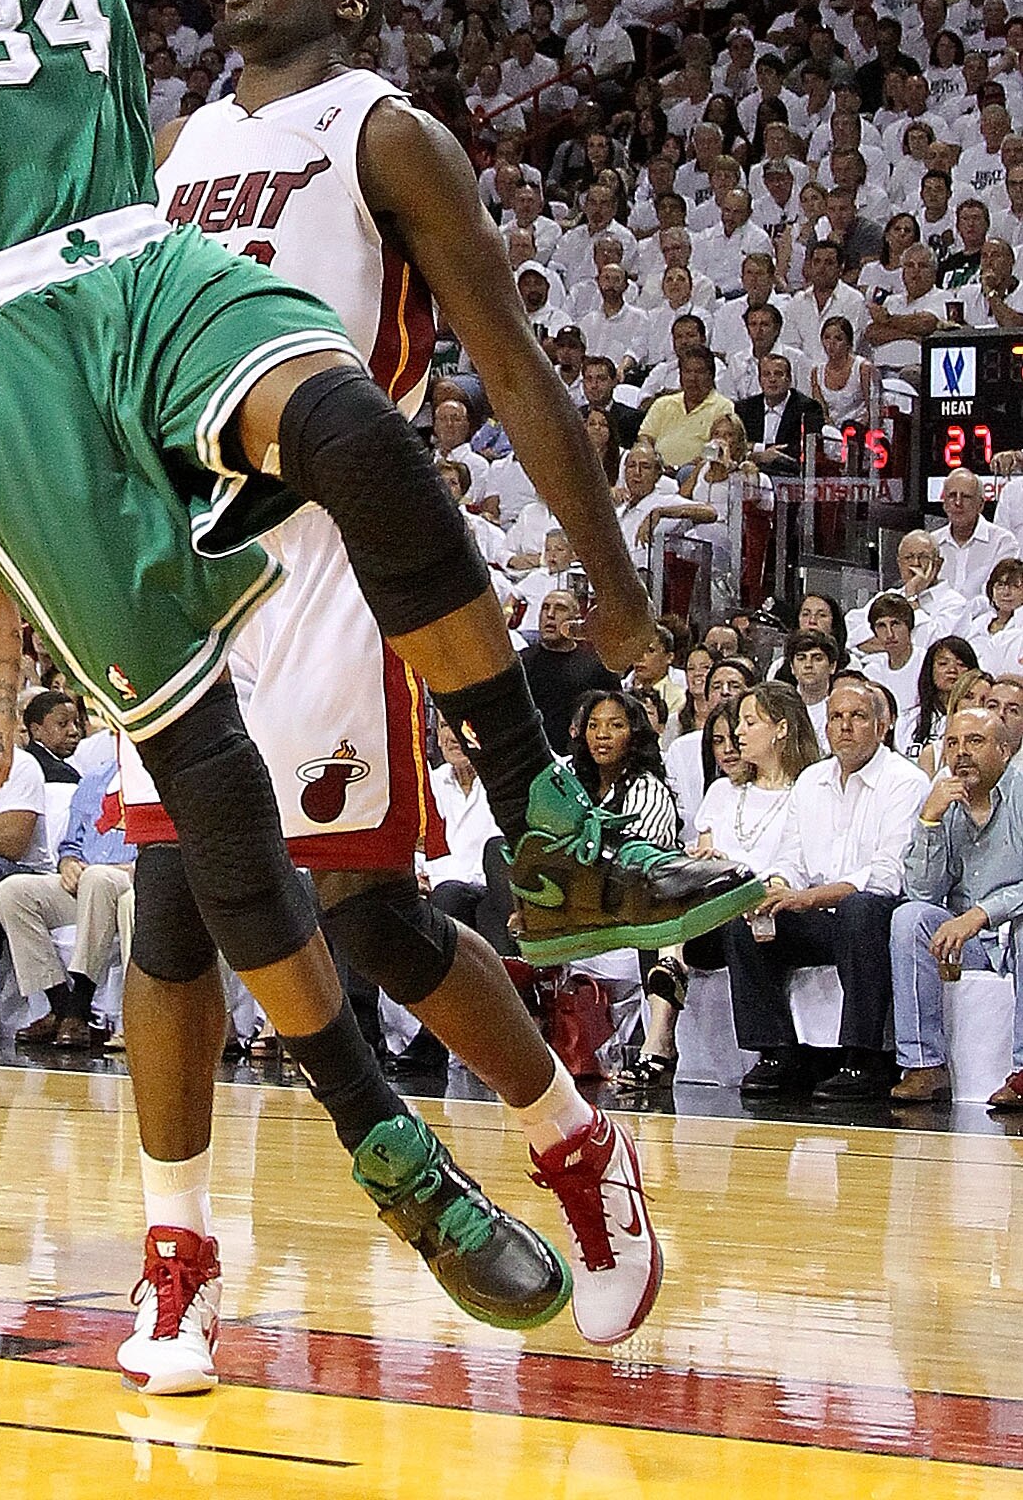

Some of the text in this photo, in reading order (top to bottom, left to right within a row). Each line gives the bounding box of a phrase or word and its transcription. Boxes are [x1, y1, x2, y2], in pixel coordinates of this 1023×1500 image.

[165, 154, 332, 233] HEAT
[941, 401, 974, 416] HEAT
[943, 425, 993, 468] 27
